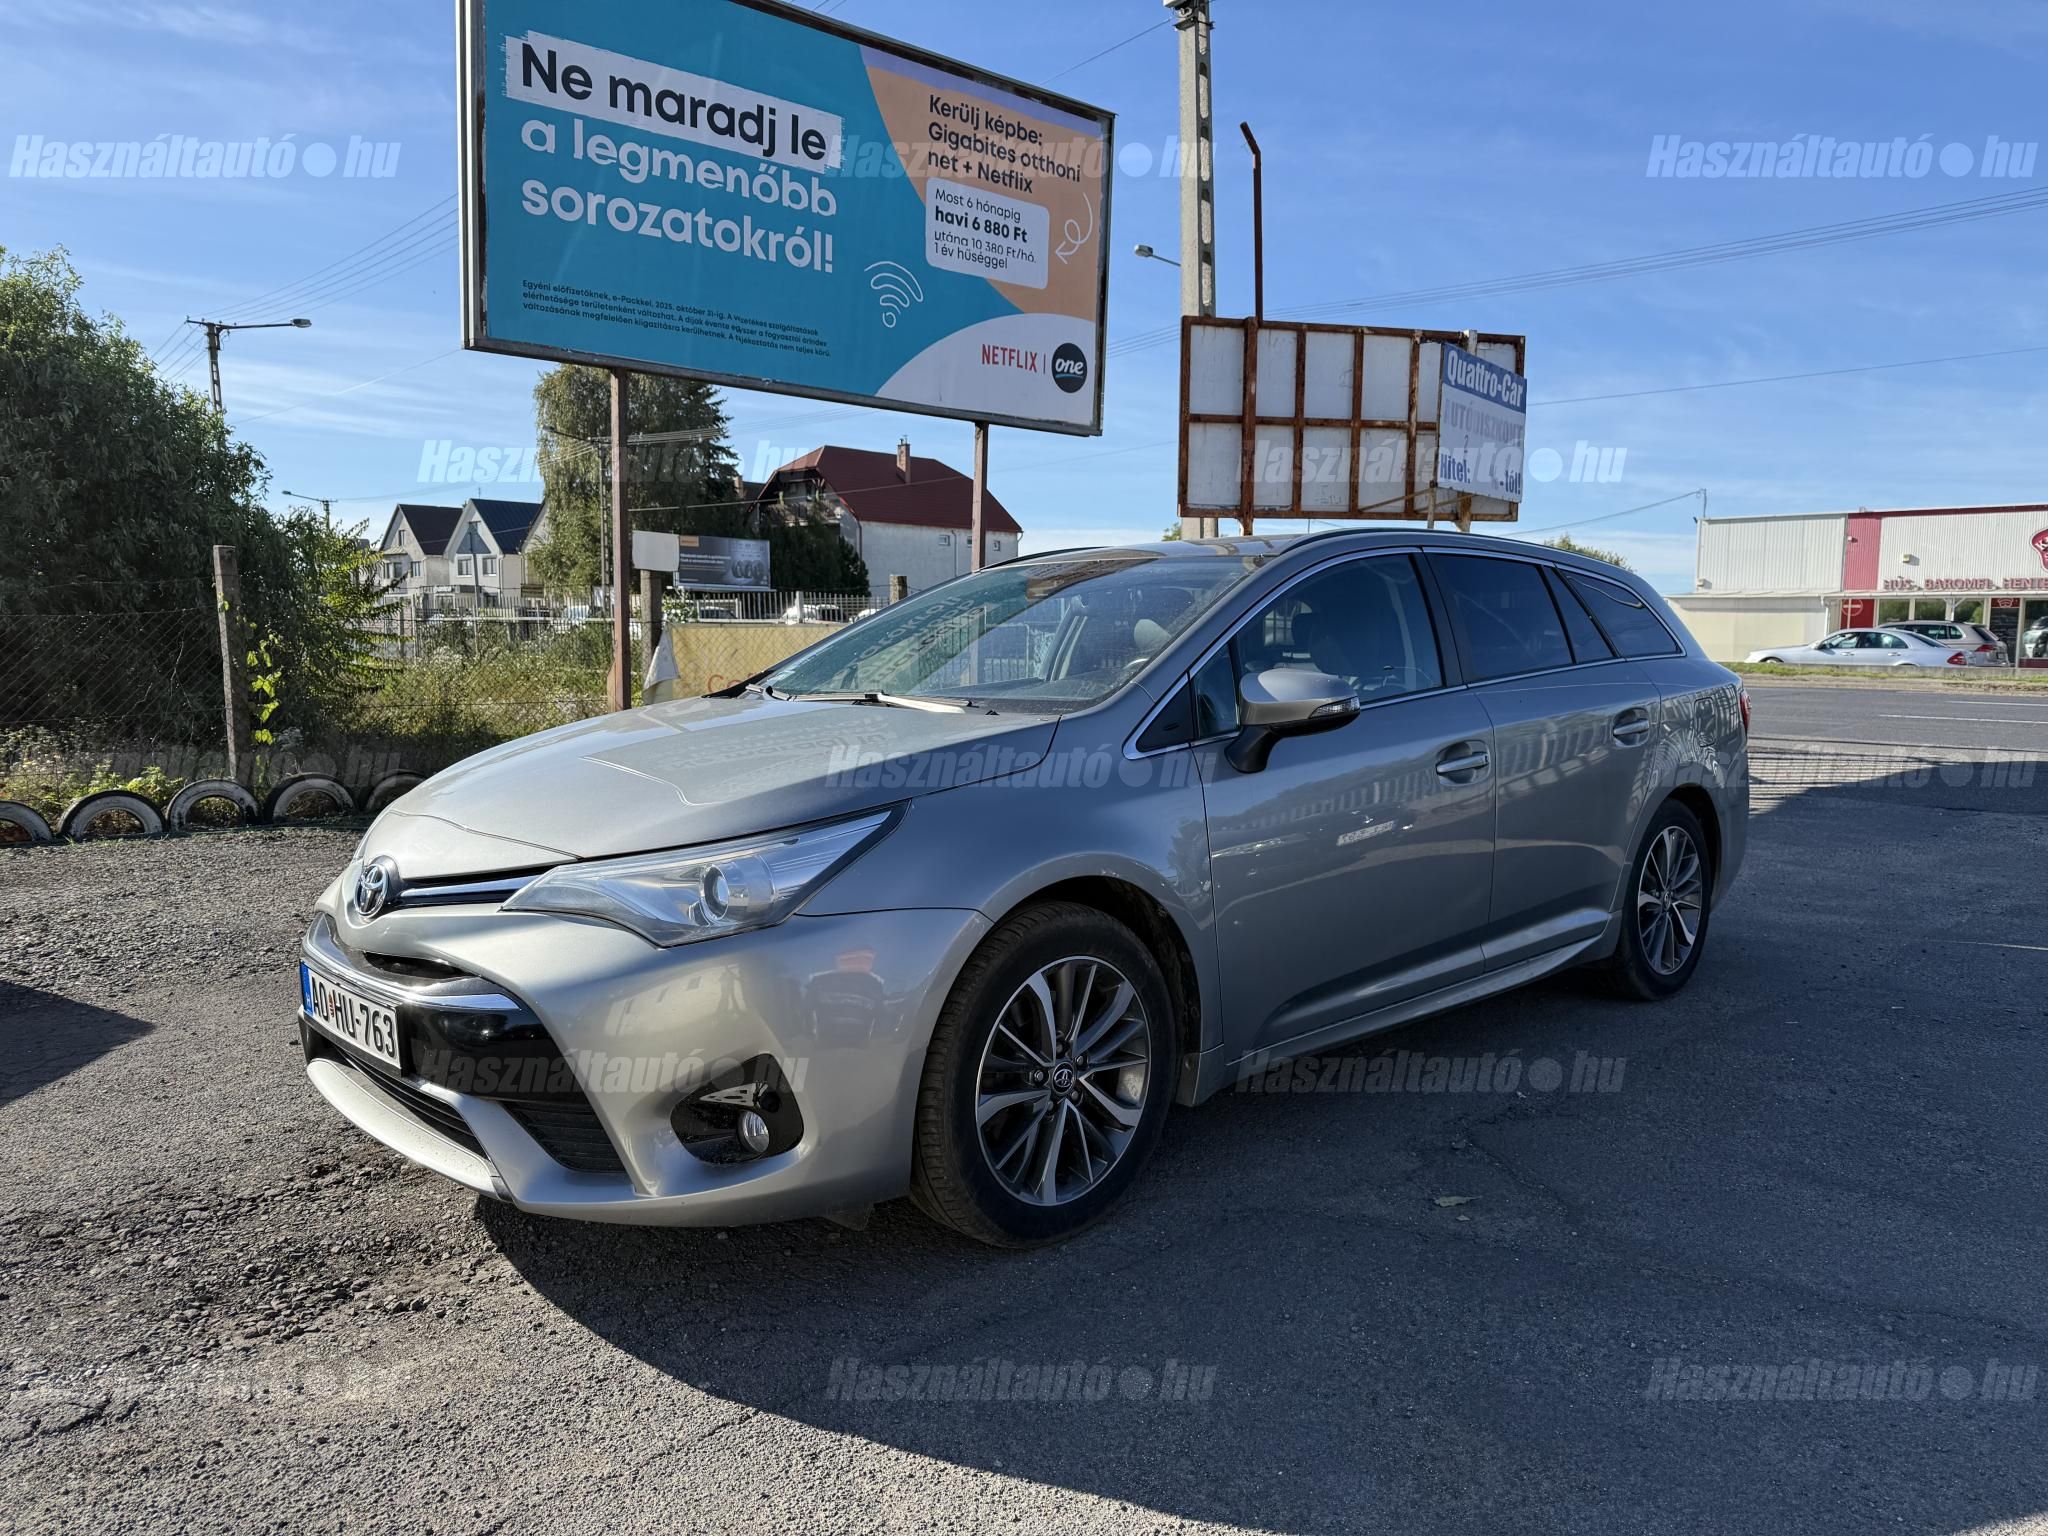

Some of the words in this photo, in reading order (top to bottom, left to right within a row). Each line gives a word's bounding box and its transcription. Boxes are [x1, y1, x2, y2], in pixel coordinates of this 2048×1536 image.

[522, 42, 592, 100] Ne
[609, 75, 776, 157] maradj
[791, 114, 826, 160] le
[930, 94, 980, 130] Kerülj
[985, 111, 1042, 146] képbe:
[521, 119, 555, 153] a
[574, 118, 836, 216] legmenőbb
[928, 151, 958, 172] net
[963, 161, 972, 174] +
[978, 162, 1032, 193] Netflix
[929, 122, 1016, 163] Gigabites
[1021, 153, 1080, 182] otthoni
[522, 180, 833, 273] sorozatokról!
[935, 188, 963, 206] Most
[966, 197, 973, 208] 6
[976, 198, 1021, 223] hónapig
[935, 205, 968, 228] havi
[972, 217, 980, 231] 6
[984, 220, 1010, 239] 880
[1014, 227, 1027, 243] Ft
[934, 230, 968, 247] utána
[972, 238, 982, 250] 10
[985, 241, 1003, 255] 380
[1007, 246, 1036, 263] Ft/hó.
[934, 242, 939, 254] 1
[941, 243, 954, 257] év
[957, 246, 1008, 269] hűséggel
[523, 280, 551, 290] Egyéni
[553, 284, 611, 301] előfizetőknek,
[656, 300, 674, 310] 2025.
[676, 305, 706, 315] október
[768, 322, 818, 336] szolgáltatások
[523, 291, 579, 306] elérhetősége
[581, 300, 636, 315] területenként
[637, 308, 674, 321] változhat.
[679, 314, 684, 322] A
[685, 316, 703, 326] díjak
[705, 320, 729, 330] évente
[523, 302, 580, 316] változásának
[582, 311, 633, 324] megfelelően
[780, 343, 794, 352] nem
[796, 346, 813, 355] teljes
[982, 344, 1037, 373] NETFLIX
[1055, 358, 1084, 375] one
[1447, 350, 1523, 407] Quattro-Car
[1440, 453, 1470, 484] Hitel:
[311, 976, 329, 1022] AO
[332, 989, 396, 1058] HU-763
